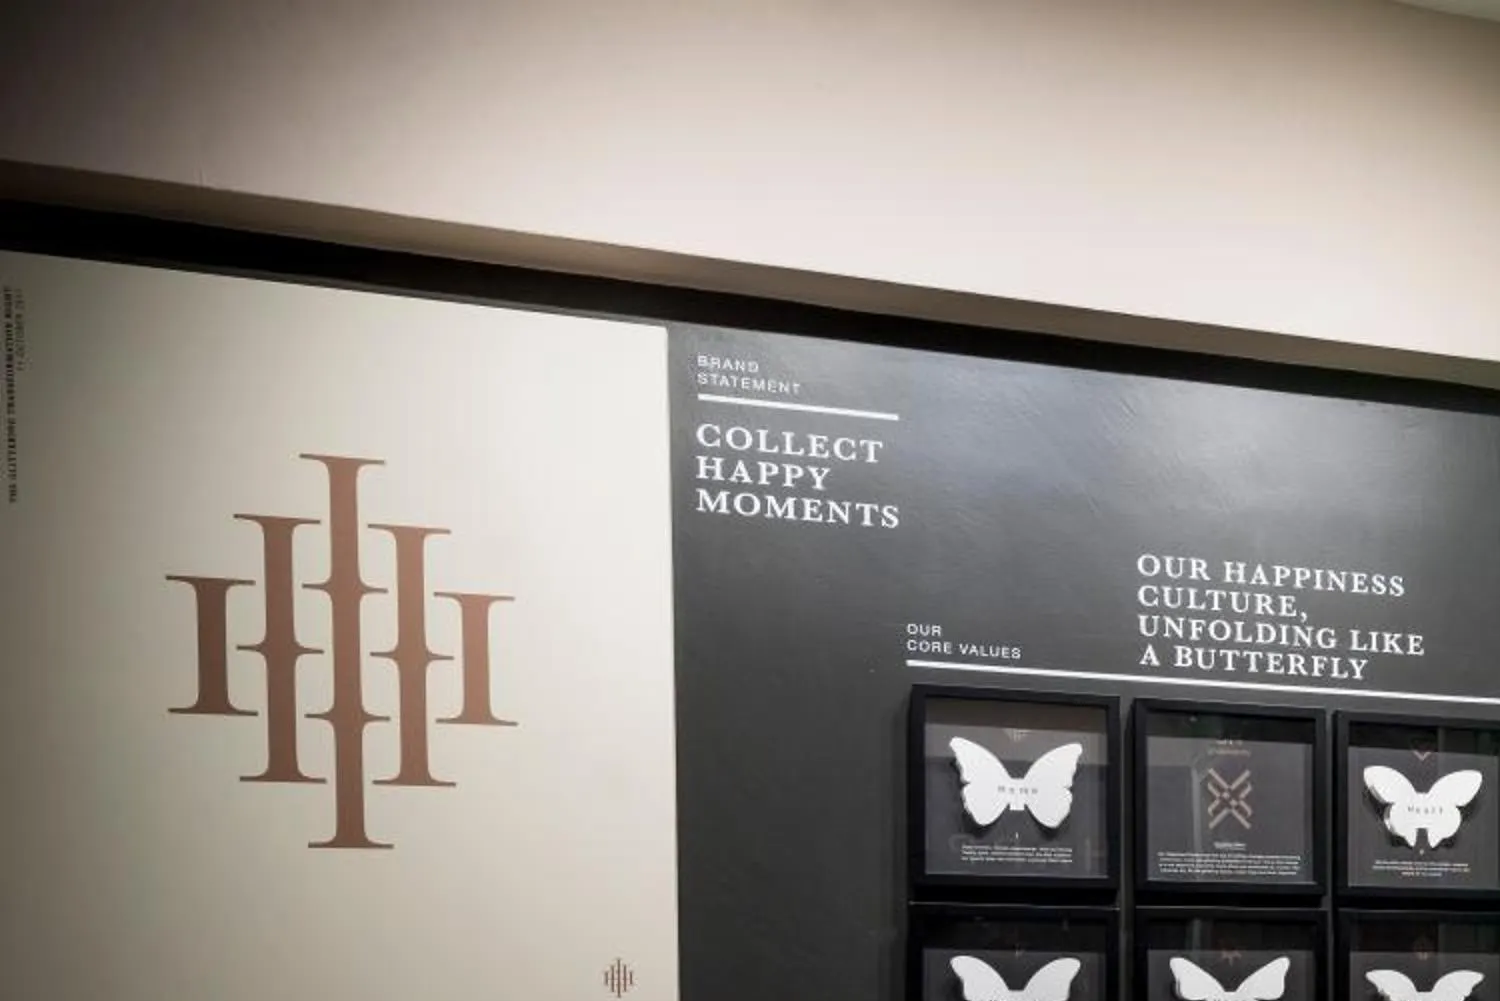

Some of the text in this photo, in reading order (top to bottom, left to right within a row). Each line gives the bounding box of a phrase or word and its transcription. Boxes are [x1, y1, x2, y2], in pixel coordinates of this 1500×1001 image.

[697, 355, 759, 373] BRAND
[697, 373, 800, 394] STATEMENT
[696, 423, 883, 463] COLLECT
[696, 456, 831, 490] HAPPY
[696, 488, 899, 528] MOMENTS
[1137, 553, 1405, 597] OUR HAPPINESS
[1137, 585, 1308, 622] CULTURE,
[906, 623, 942, 637] OUR
[1137, 615, 1424, 656] UNFOLDING LIKE
[906, 639, 1021, 659] CORE VALUES
[1139, 644, 1368, 679] A BUTTERFLY
